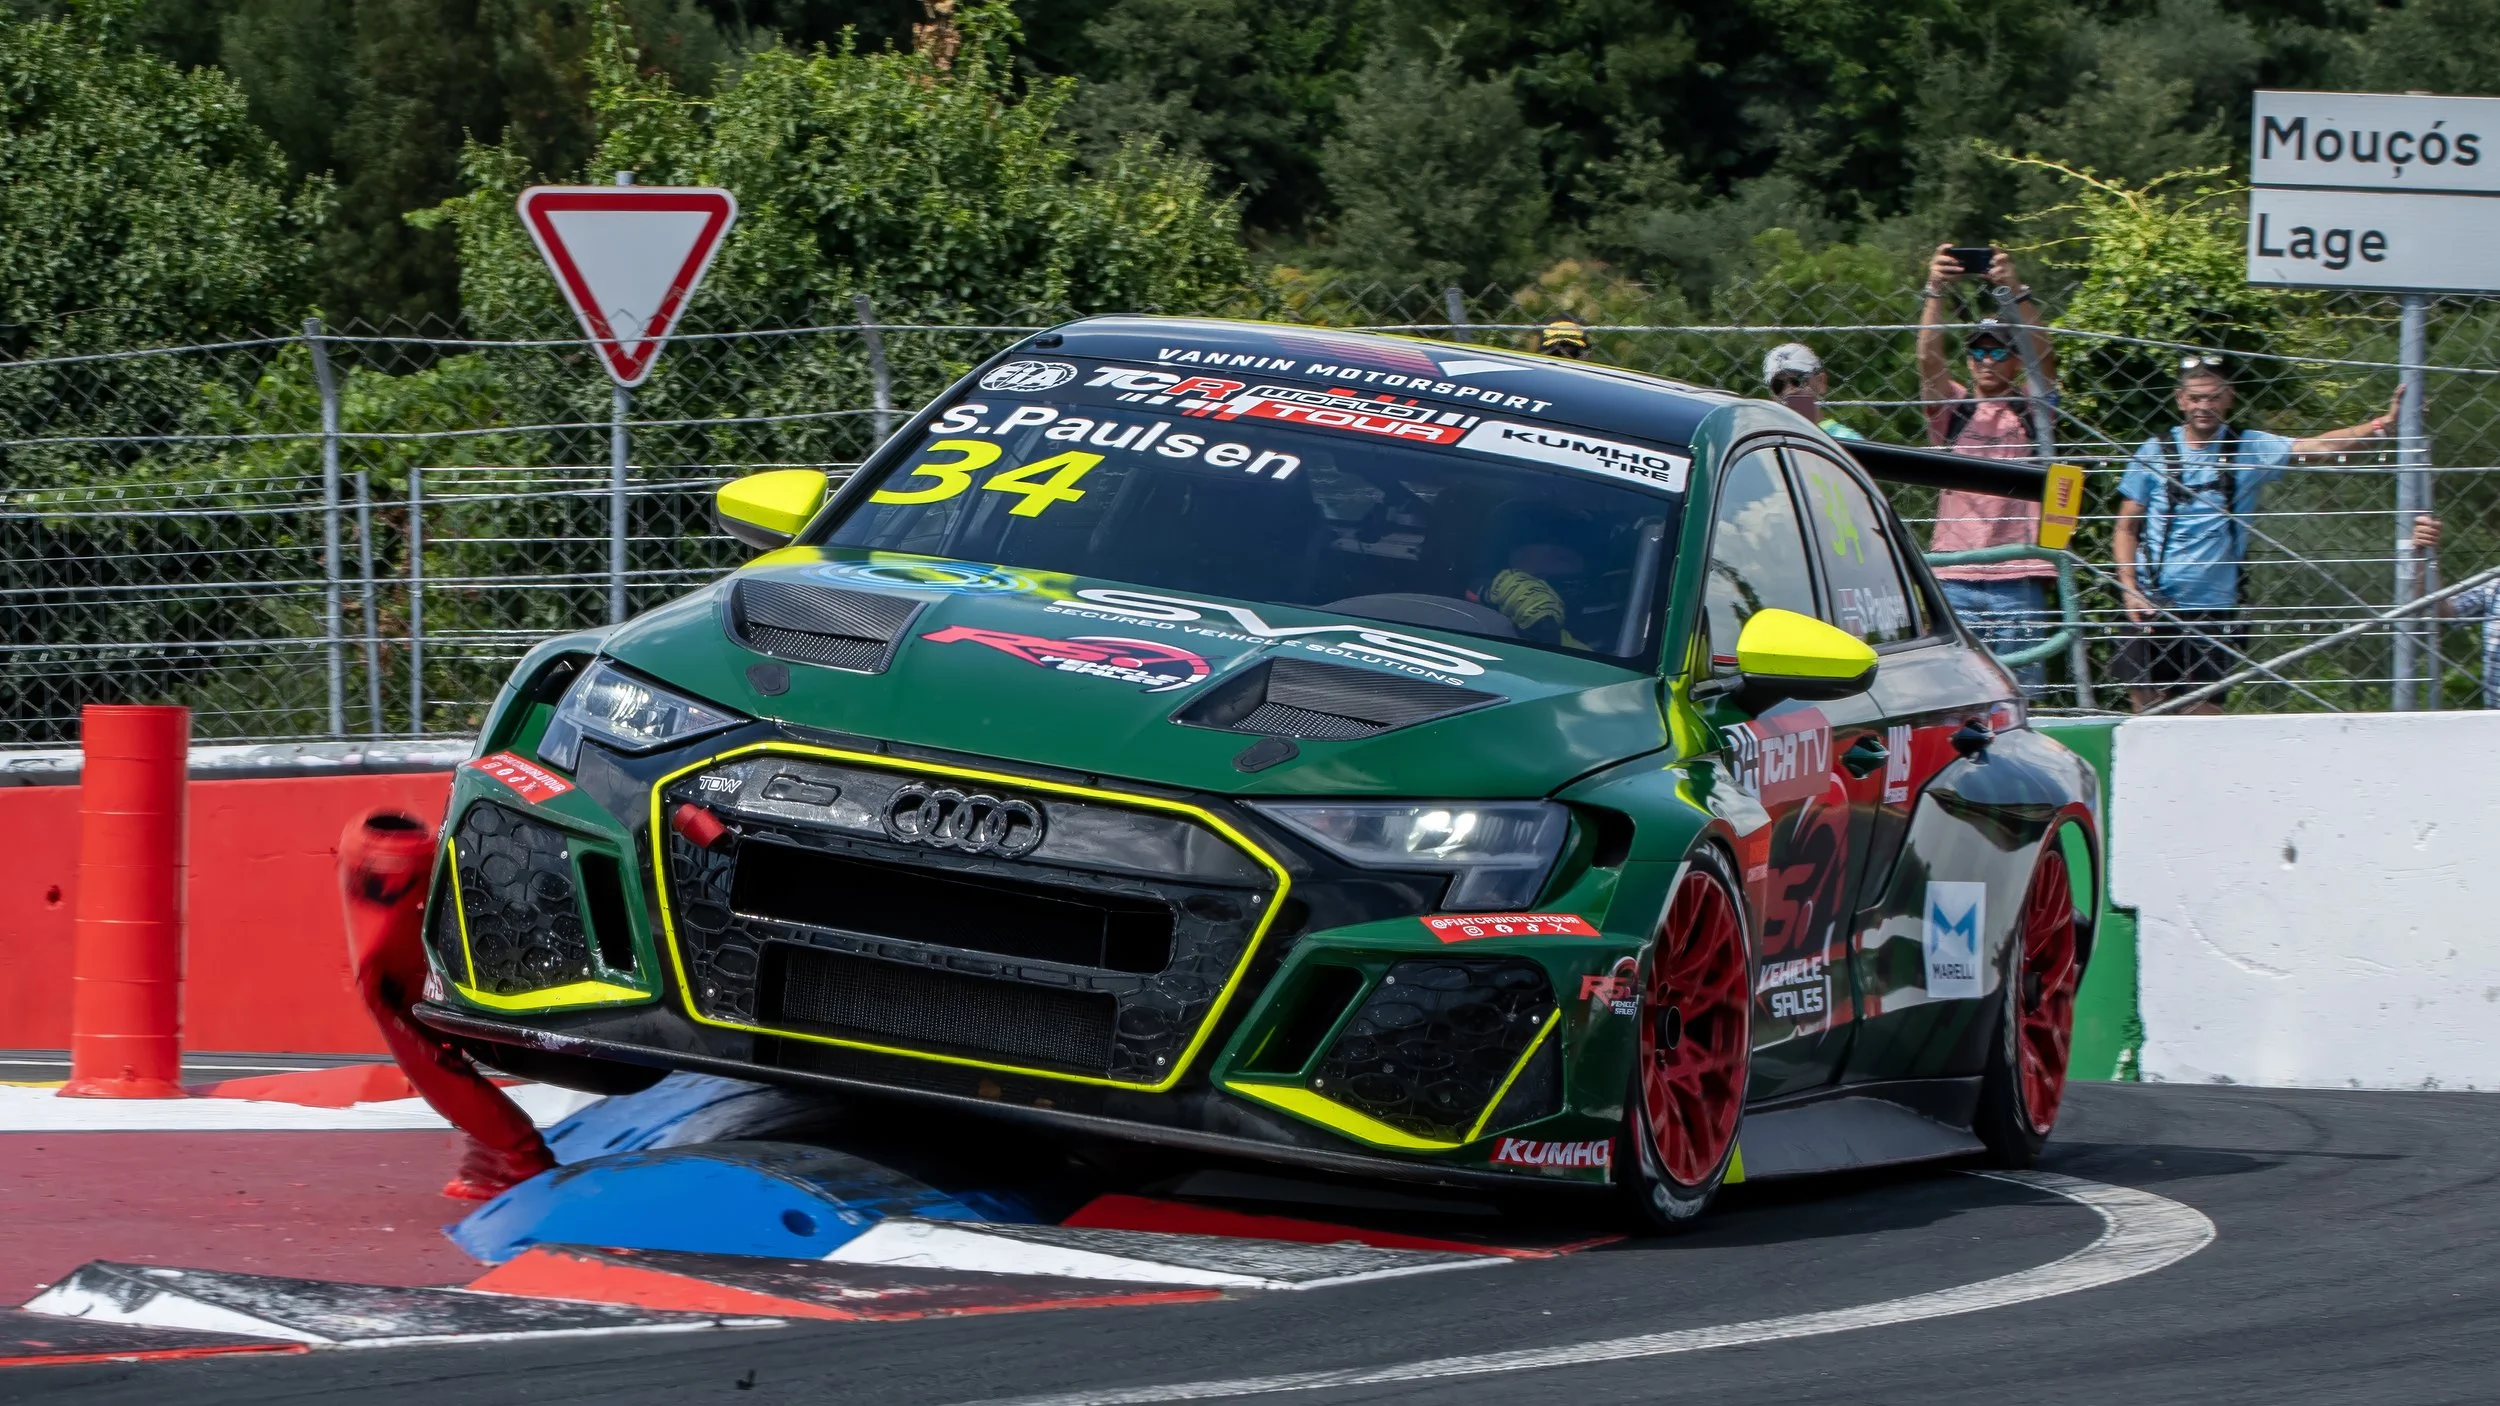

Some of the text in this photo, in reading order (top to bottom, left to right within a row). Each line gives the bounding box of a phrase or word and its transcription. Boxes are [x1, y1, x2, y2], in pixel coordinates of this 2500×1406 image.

[2260, 115, 2482, 179] Mouçós
[2256, 212, 2389, 270] Lage
[982, 362, 1066, 390] FIA
[1083, 366, 1247, 401] TCR
[1157, 347, 1553, 413] VANNIN MOTORSPORT
[1259, 387, 1423, 418] WORLD
[1271, 404, 1446, 441] TOUR
[928, 403, 1301, 481] S.Paulsen
[1501, 428, 1672, 472] KUMHO
[868, 439, 1107, 519] 34
[1596, 456, 1670, 483] TIRE
[1042, 604, 1466, 687] SECURED VEHICLE SOLUTIONS
[699, 775, 743, 794] TOW
[1771, 986, 1824, 1019] SALES
[1498, 1137, 1610, 1167] KUMHO
